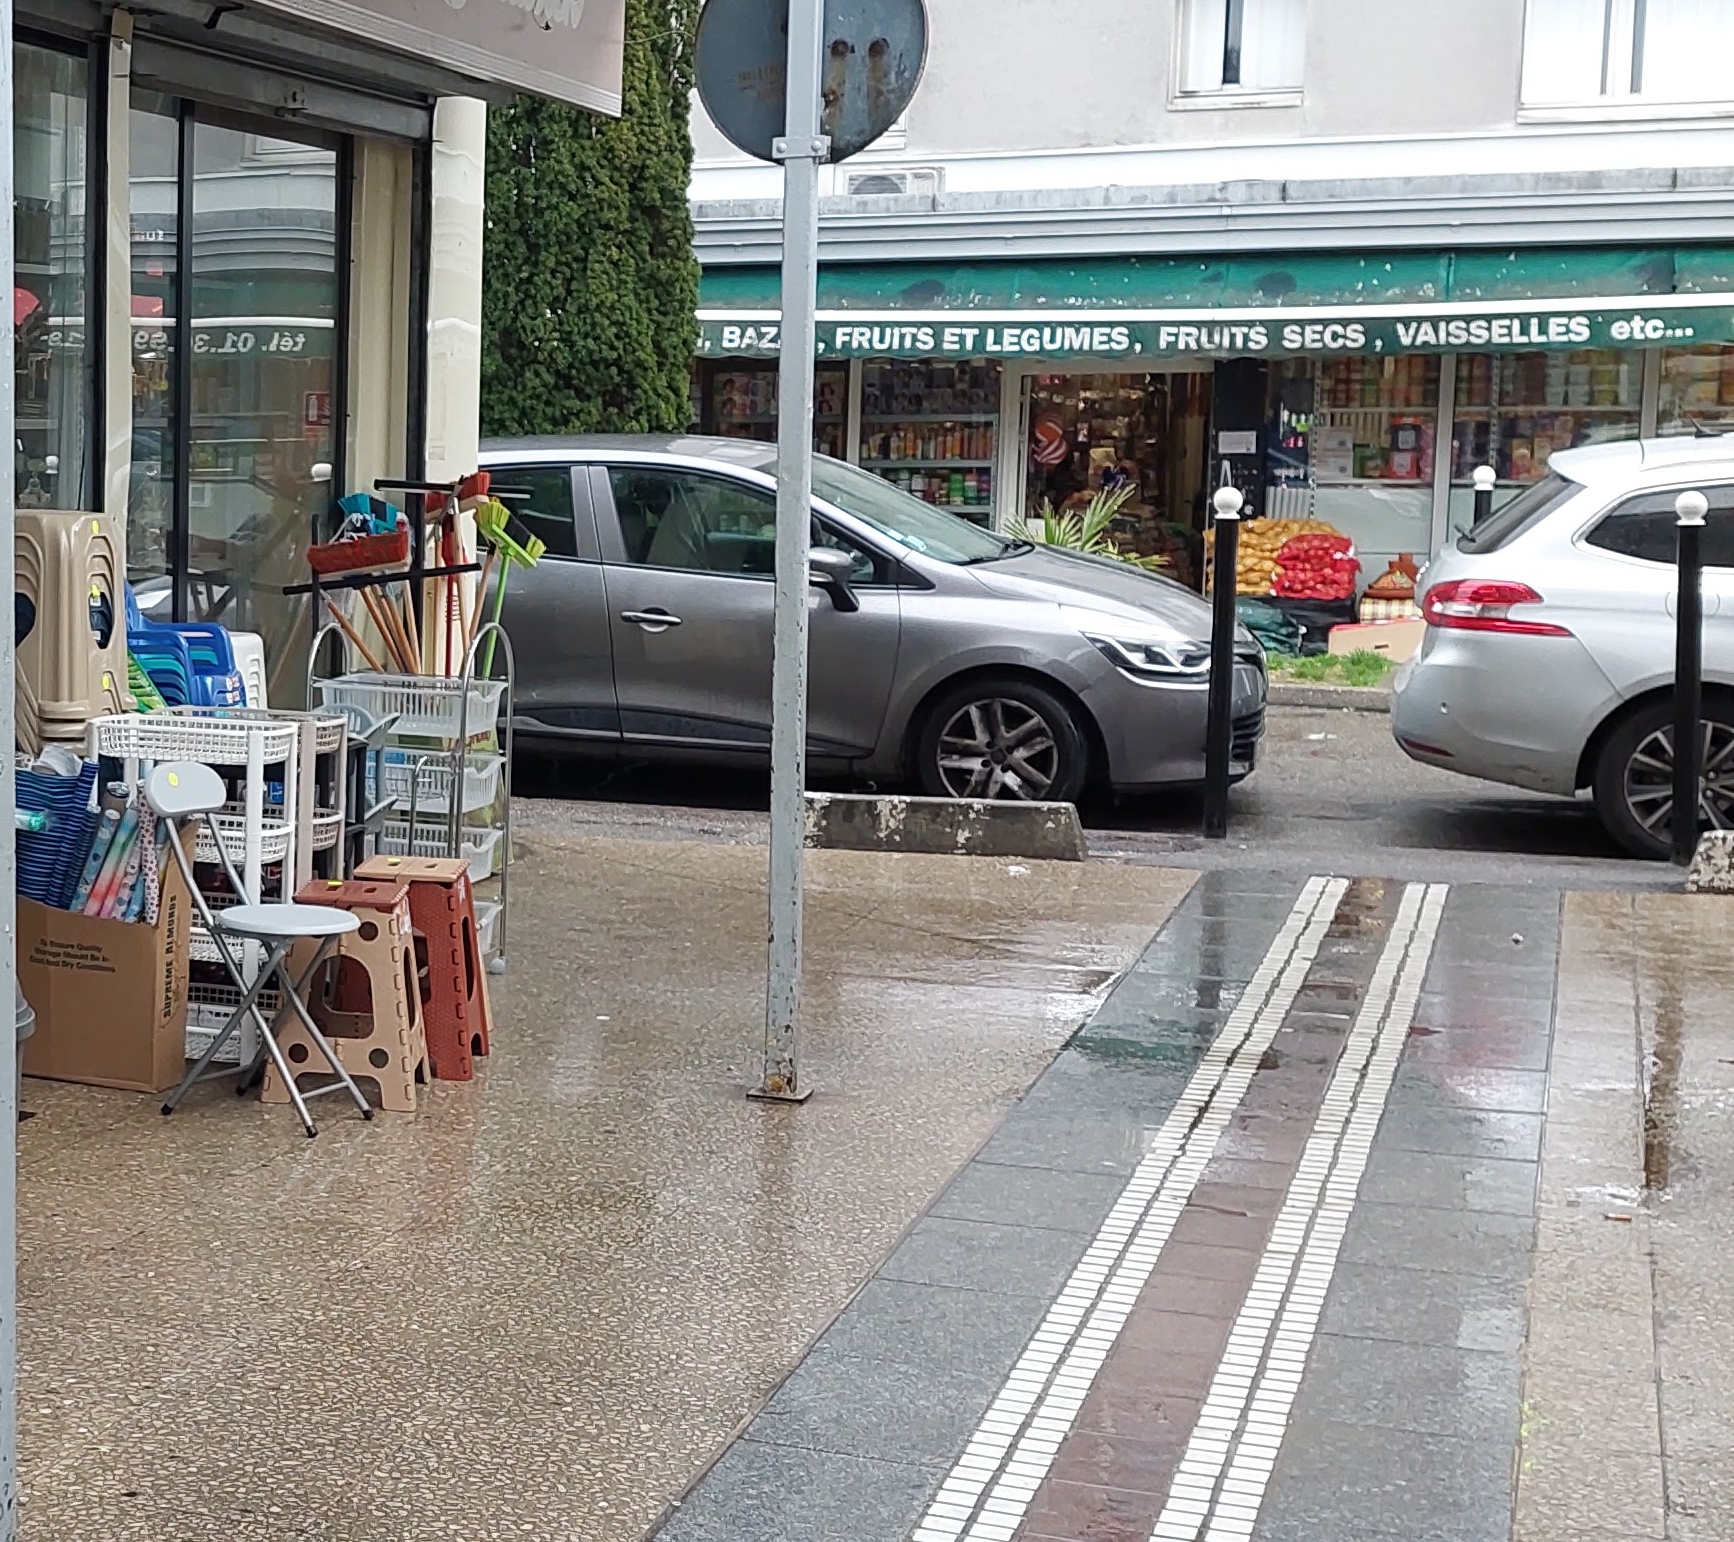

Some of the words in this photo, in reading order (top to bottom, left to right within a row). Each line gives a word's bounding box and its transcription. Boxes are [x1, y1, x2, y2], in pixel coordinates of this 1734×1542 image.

[835, 326, 935, 350] FRUITS
[942, 326, 980, 350] ET
[1159, 324, 1269, 350] FRUITS
[1396, 315, 1591, 346] VAISSELLES
[1610, 314, 1694, 340] etc...
[61, 959, 74, 970] Dry
